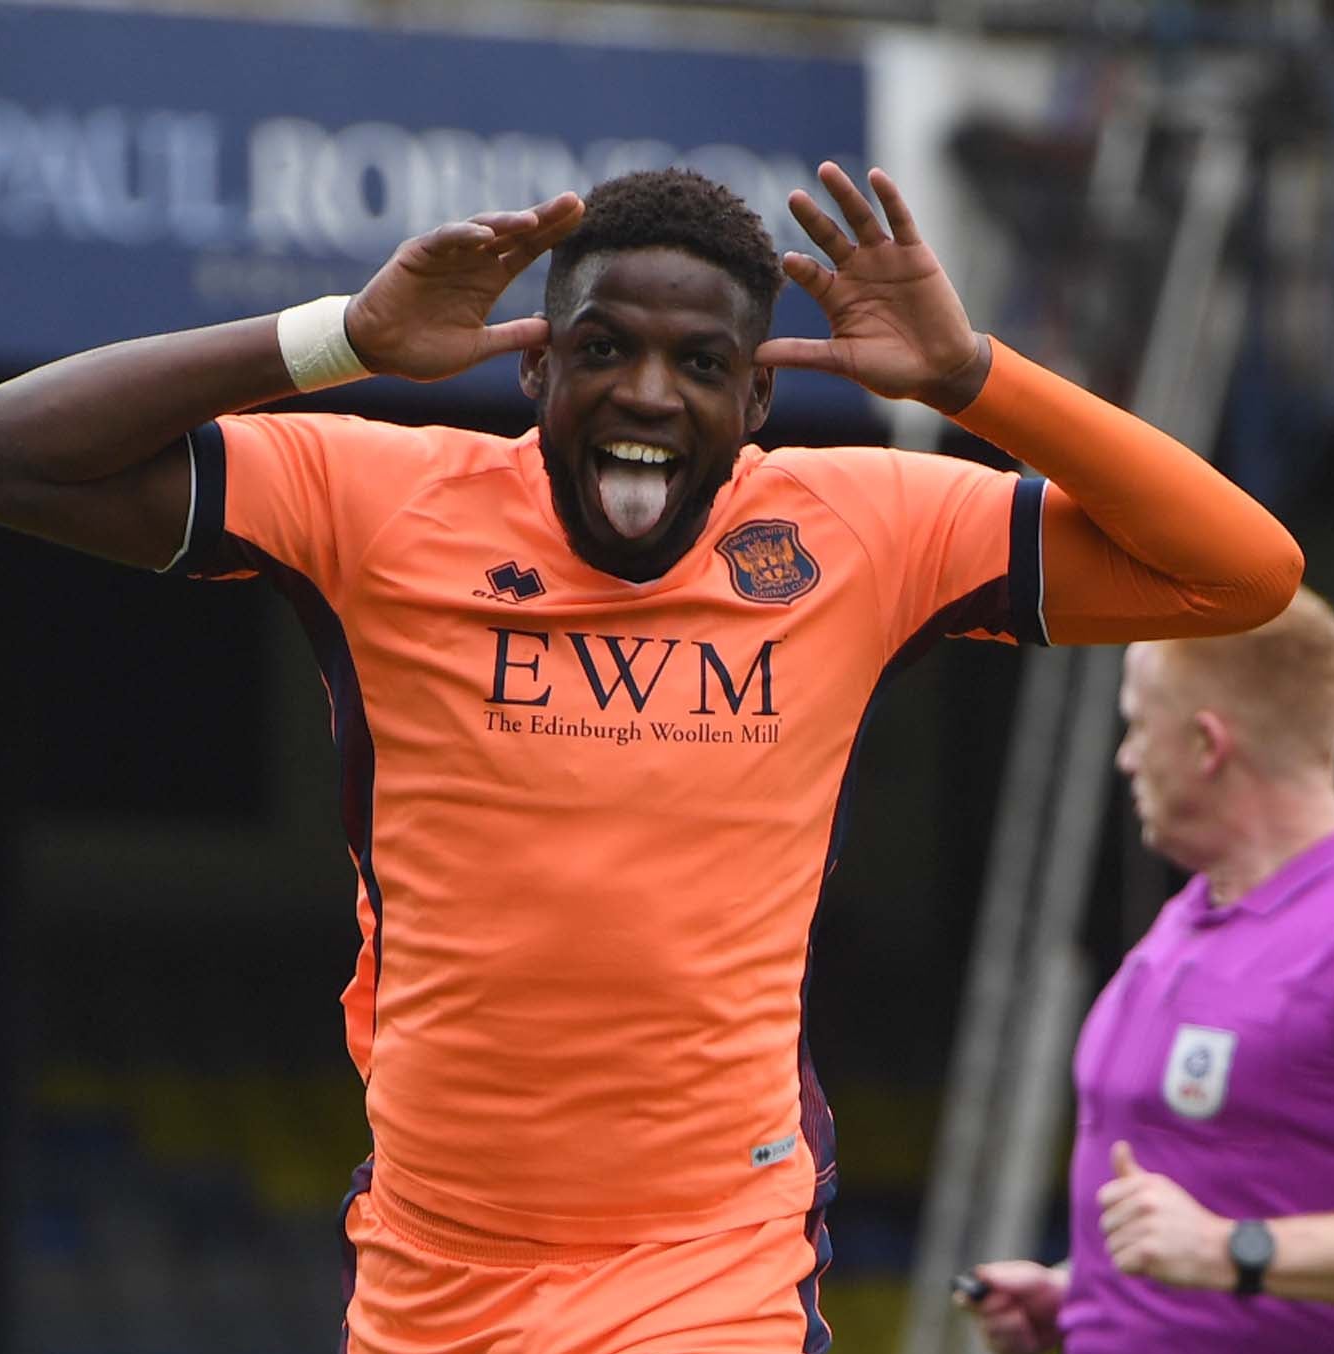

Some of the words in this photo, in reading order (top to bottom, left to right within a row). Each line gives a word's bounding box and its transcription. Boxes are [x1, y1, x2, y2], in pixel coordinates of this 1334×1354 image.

[483, 627, 782, 716] EWM
[483, 711, 523, 733] The
[530, 715, 641, 745] Edinburgh
[650, 722, 734, 743] Woollen
[741, 722, 780, 744] Mill
